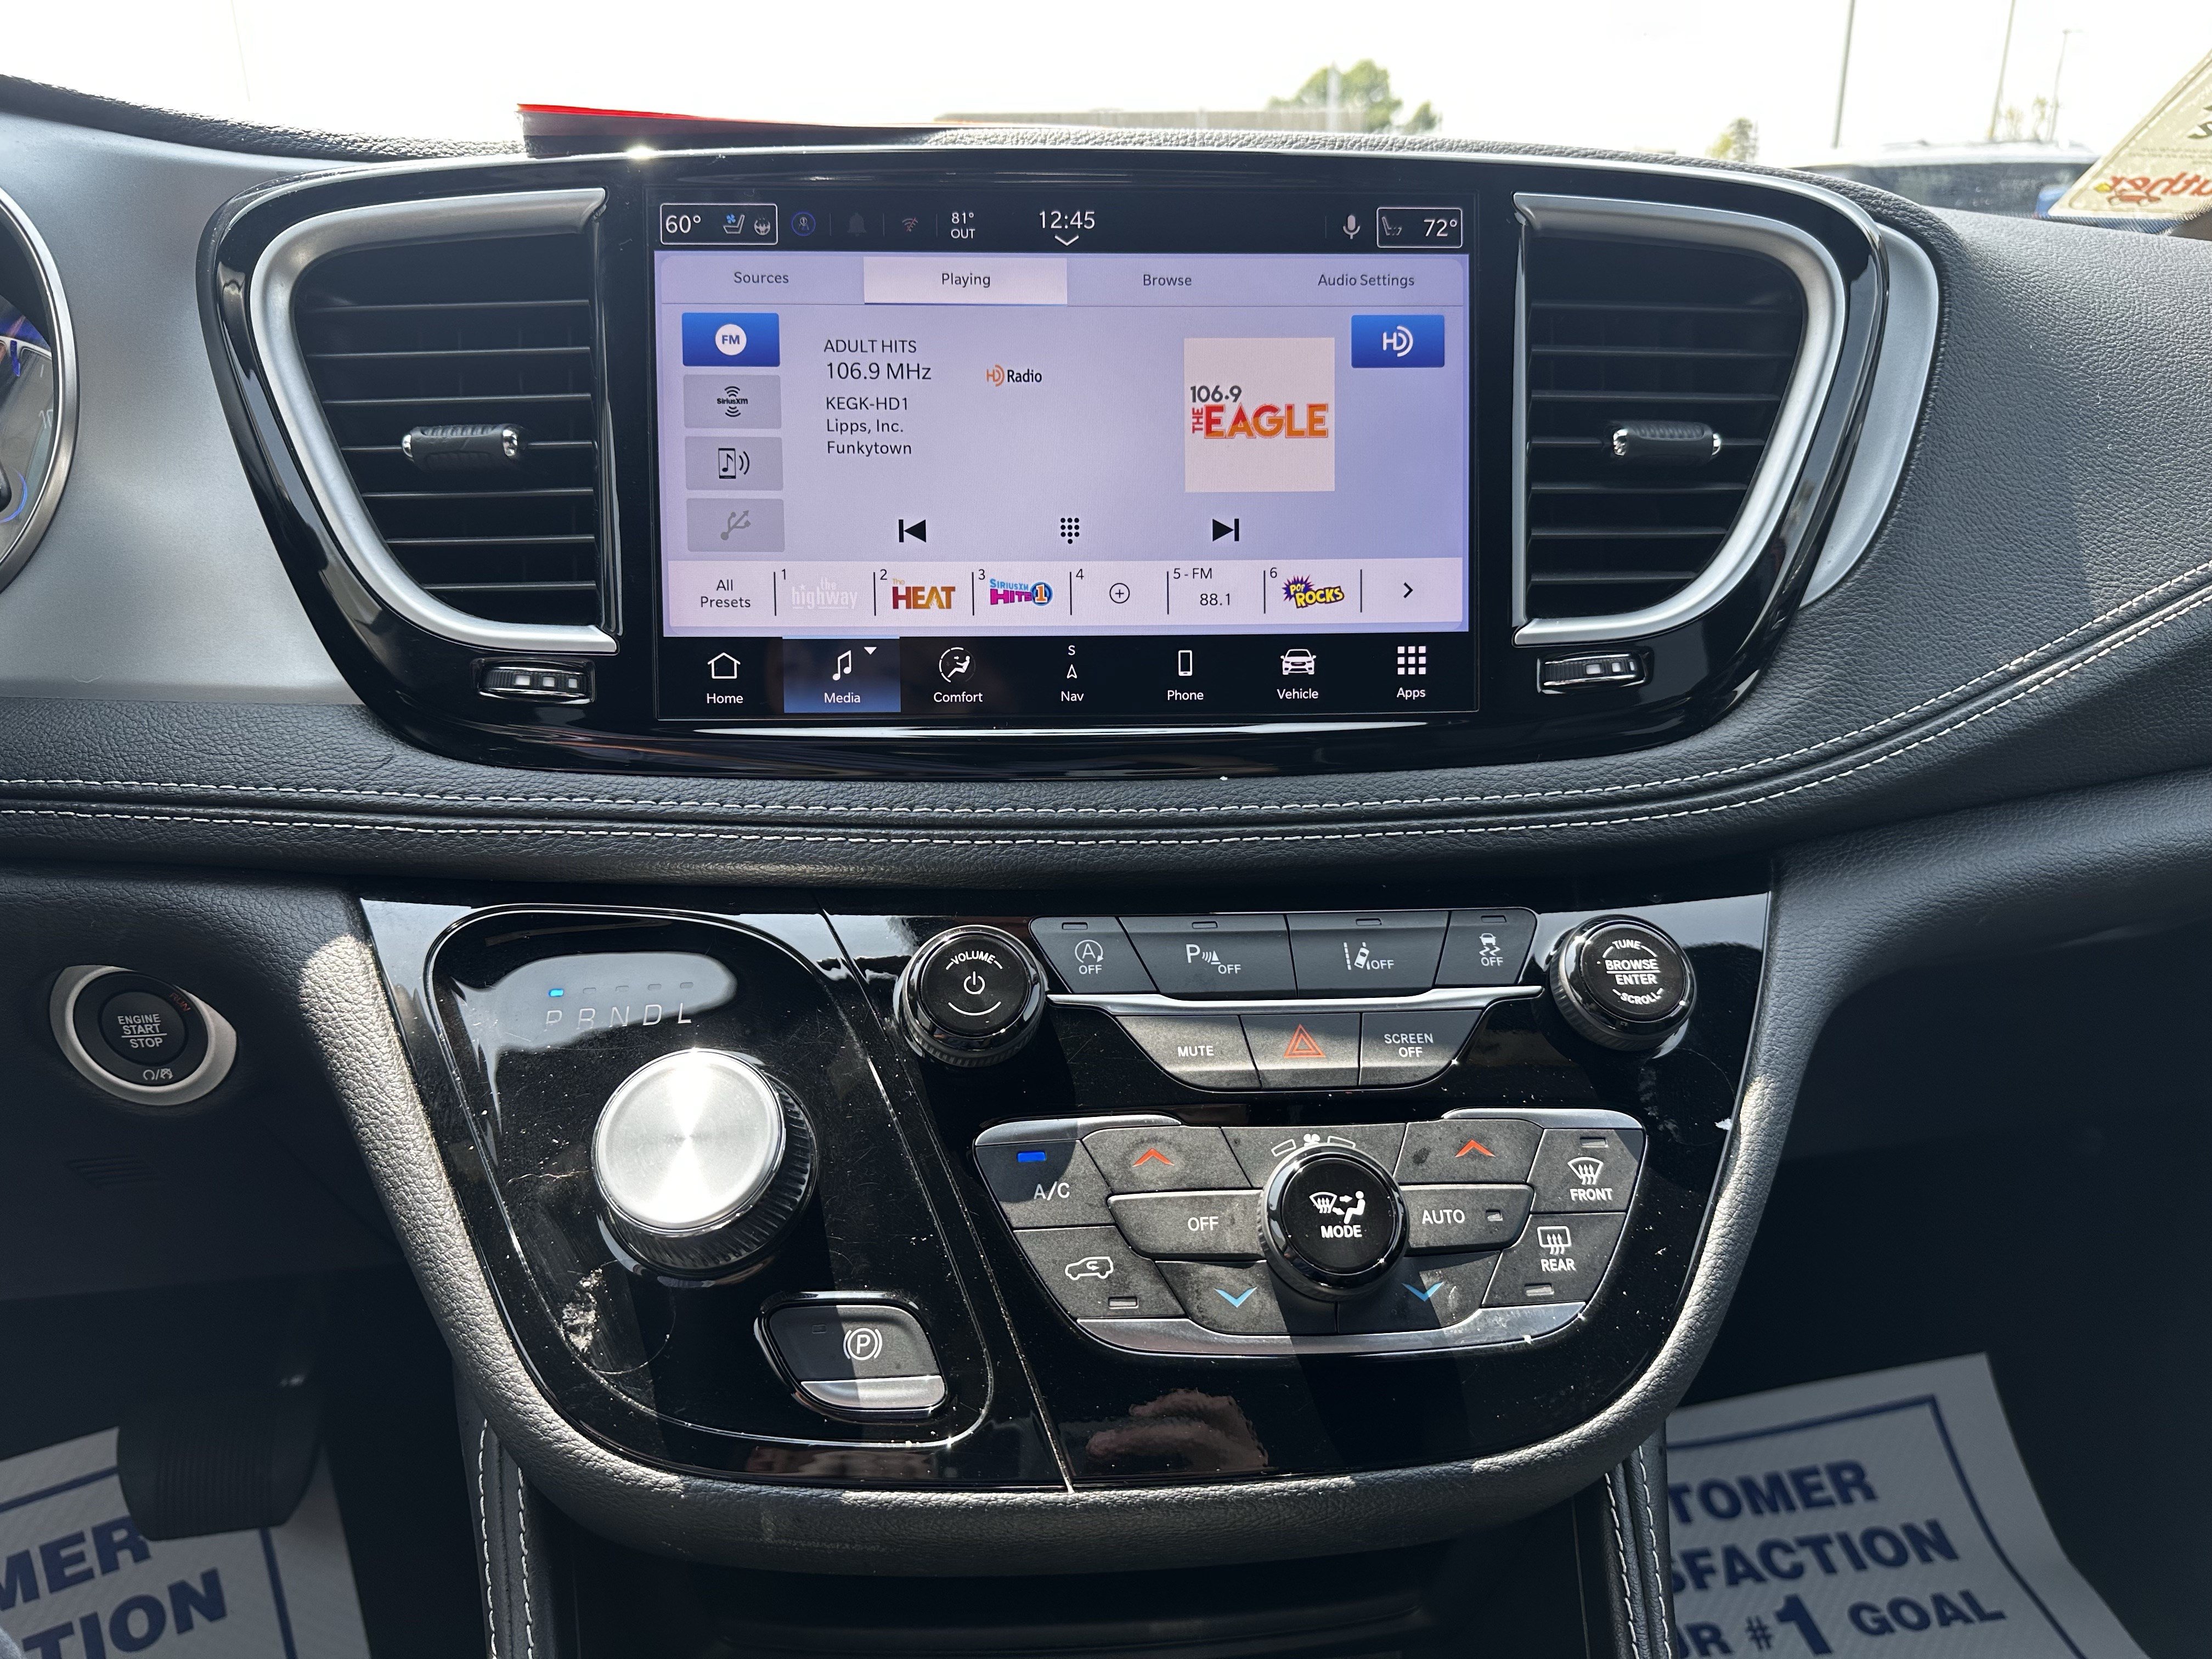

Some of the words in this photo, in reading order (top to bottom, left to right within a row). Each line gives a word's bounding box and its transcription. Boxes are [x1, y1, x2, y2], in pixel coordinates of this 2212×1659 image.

[664, 215, 702, 234] 60°
[951, 212, 974, 225] 81°
[1039, 211, 1095, 230] 12:45
[951, 229, 975, 239] OUT
[1423, 219, 1458, 237] 72°
[733, 272, 789, 284] Sources
[941, 273, 990, 288] Playing
[1143, 274, 1192, 286] Browse
[1318, 274, 1357, 286] Audio
[1360, 273, 1415, 288] Settings
[721, 335, 741, 345] FM
[823, 340, 878, 354] ADULT
[882, 340, 917, 354] HITS
[827, 362, 881, 380] 106.9
[886, 362, 932, 380] MHz
[1007, 368, 1043, 383] Radio
[1189, 385, 1243, 403] 106.9
[826, 397, 909, 411] KEGK-HD1
[827, 419, 872, 435] Lipps,
[876, 419, 905, 433] Inc.
[1192, 407, 1204, 433] THE
[1204, 403, 1329, 439] EAGLE
[827, 441, 913, 457] Funkytown
[781, 569, 787, 580] 1
[880, 569, 888, 580] 2
[978, 569, 986, 580] 3
[1075, 568, 1085, 580] 4
[1173, 568, 1180, 579] 5
[1192, 568, 1213, 579] FM
[1269, 567, 1278, 578] 6
[716, 579, 733, 591] All
[820, 577, 838, 590] the
[791, 585, 858, 610] highway
[892, 586, 956, 610] HEAT
[990, 589, 1033, 606] HITS
[1035, 584, 1048, 603] 1
[1199, 593, 1232, 606] 88.1
[1295, 587, 1345, 607] ROCKS
[700, 596, 751, 608] Presets
[1068, 646, 1075, 655] S
[706, 693, 743, 704] Home
[823, 691, 861, 704] Media
[933, 691, 983, 703] Comfort
[1060, 691, 1084, 702] Nav
[1167, 690, 1204, 701] Phone
[1277, 688, 1319, 700] Vehicle
[1397, 687, 1426, 701] Apps
[1612, 939, 1641, 950] TUNE
[951, 950, 996, 966] VOLUME
[1371, 959, 1395, 970] OFF
[1480, 956, 1504, 967] OFF
[1605, 958, 1660, 970] BROWSE
[1078, 963, 1103, 975] OFF
[1217, 964, 1242, 975] OFF
[1615, 973, 1657, 985] ENTER
[170, 992, 190, 1012] RUN
[1620, 992, 1661, 1005] SCROLL
[117, 1013, 162, 1025] ENGINE
[122, 1023, 161, 1035] START
[129, 1037, 163, 1049] STOP
[1384, 1032, 1434, 1045] SCREEN
[1177, 1045, 1214, 1058] MUTE
[1398, 1046, 1423, 1058] OFF
[1033, 1182, 1070, 1200] A/C
[1570, 1187, 1613, 1202] FRONT
[1421, 1209, 1465, 1225] AUTO
[1187, 1216, 1219, 1232] OFF
[1320, 1224, 1363, 1239] MODE
[1540, 1257, 1576, 1273] REAR
[1745, 1594, 1833, 1658] #1
[1847, 1589, 2006, 1637] GOAL
